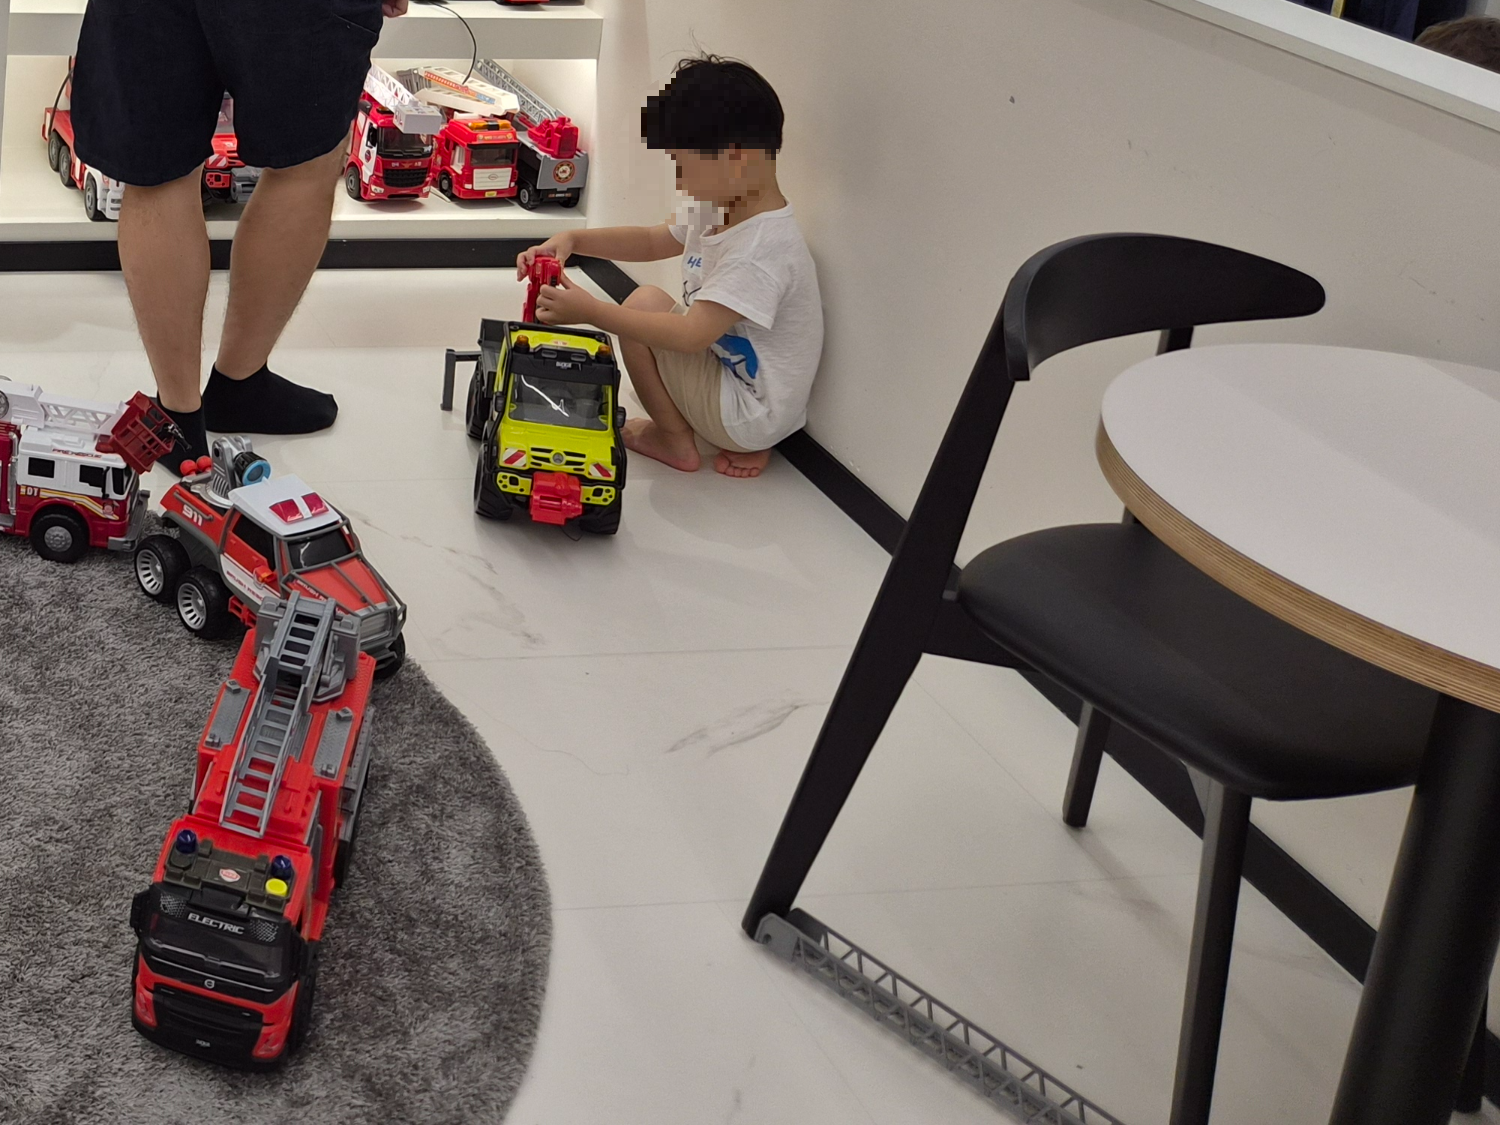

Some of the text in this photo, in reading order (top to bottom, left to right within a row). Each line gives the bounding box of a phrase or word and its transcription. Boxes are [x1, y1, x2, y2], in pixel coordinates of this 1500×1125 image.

[26, 487, 39, 497] DT
[182, 504, 203, 526] 911
[187, 912, 245, 935] ELECTRIC
